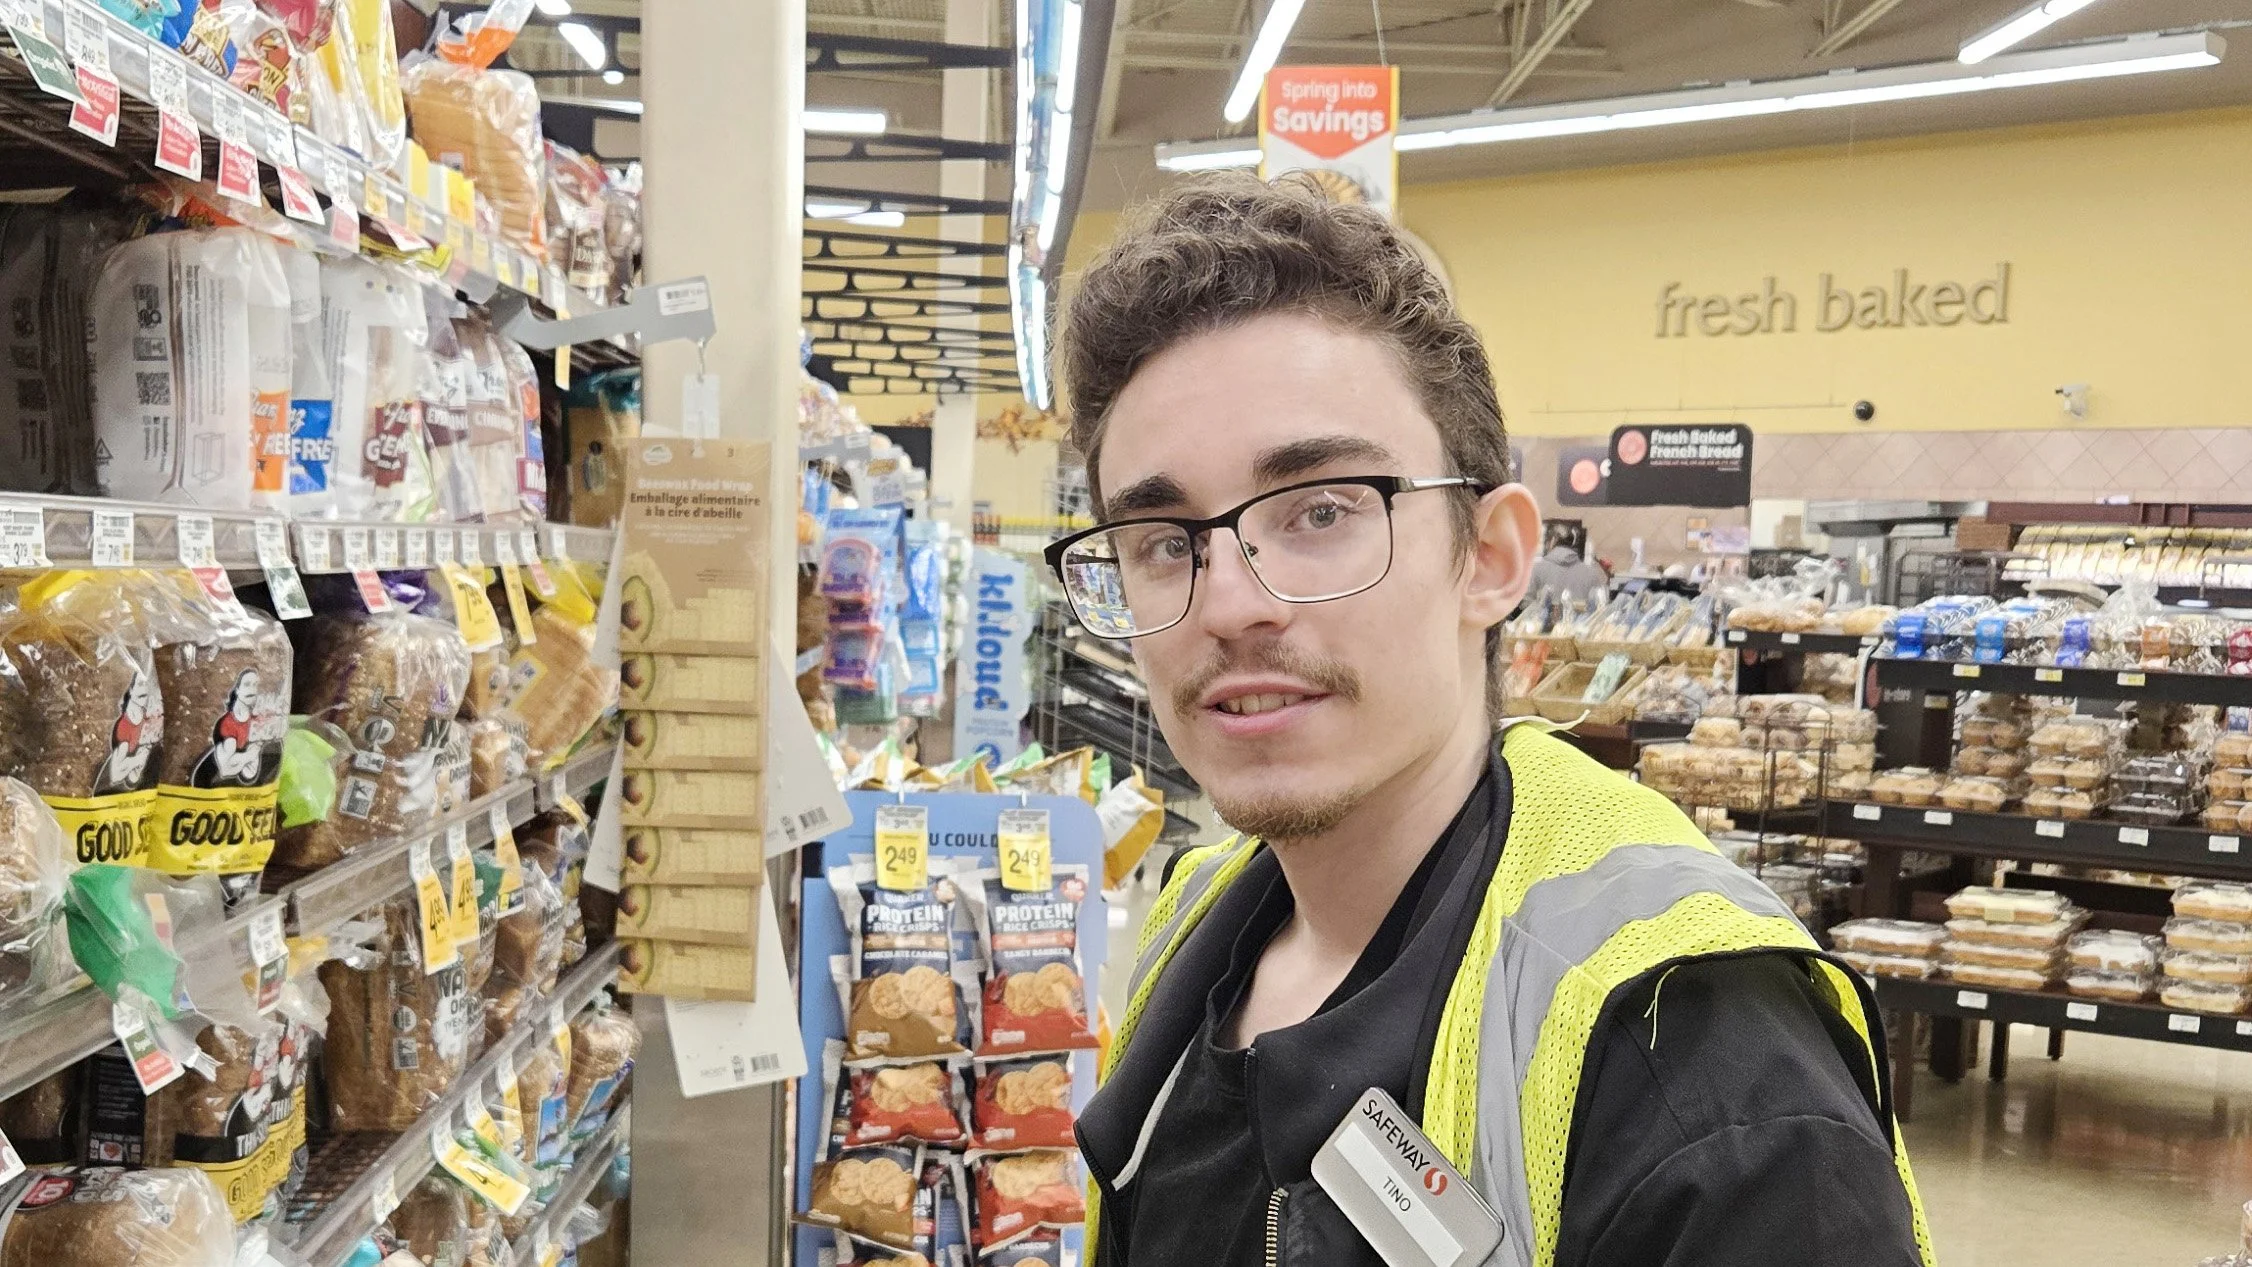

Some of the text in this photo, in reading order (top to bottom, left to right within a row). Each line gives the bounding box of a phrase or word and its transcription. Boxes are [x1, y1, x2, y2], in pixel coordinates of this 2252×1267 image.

[1282, 81, 1339, 103] Spring
[1273, 104, 1385, 140] Savings
[1655, 262, 2012, 338] fresh baked
[1651, 428, 1738, 444] Fresh Baked
[1650, 442, 1744, 459] French Bread
[630, 492, 760, 506] Emballage alimentaire
[654, 506, 665, 516] la
[668, 506, 690, 517] cire
[170, 808, 244, 846] GOOD
[77, 820, 133, 863] GOOD
[868, 904, 944, 923] PROTEIN
[995, 903, 1074, 922] PROTEIN
[873, 922, 899, 932] RICE
[1003, 922, 1029, 932] RICE
[1362, 1099, 1430, 1172] SAFEWAY
[1383, 1176, 1411, 1212] TINO
